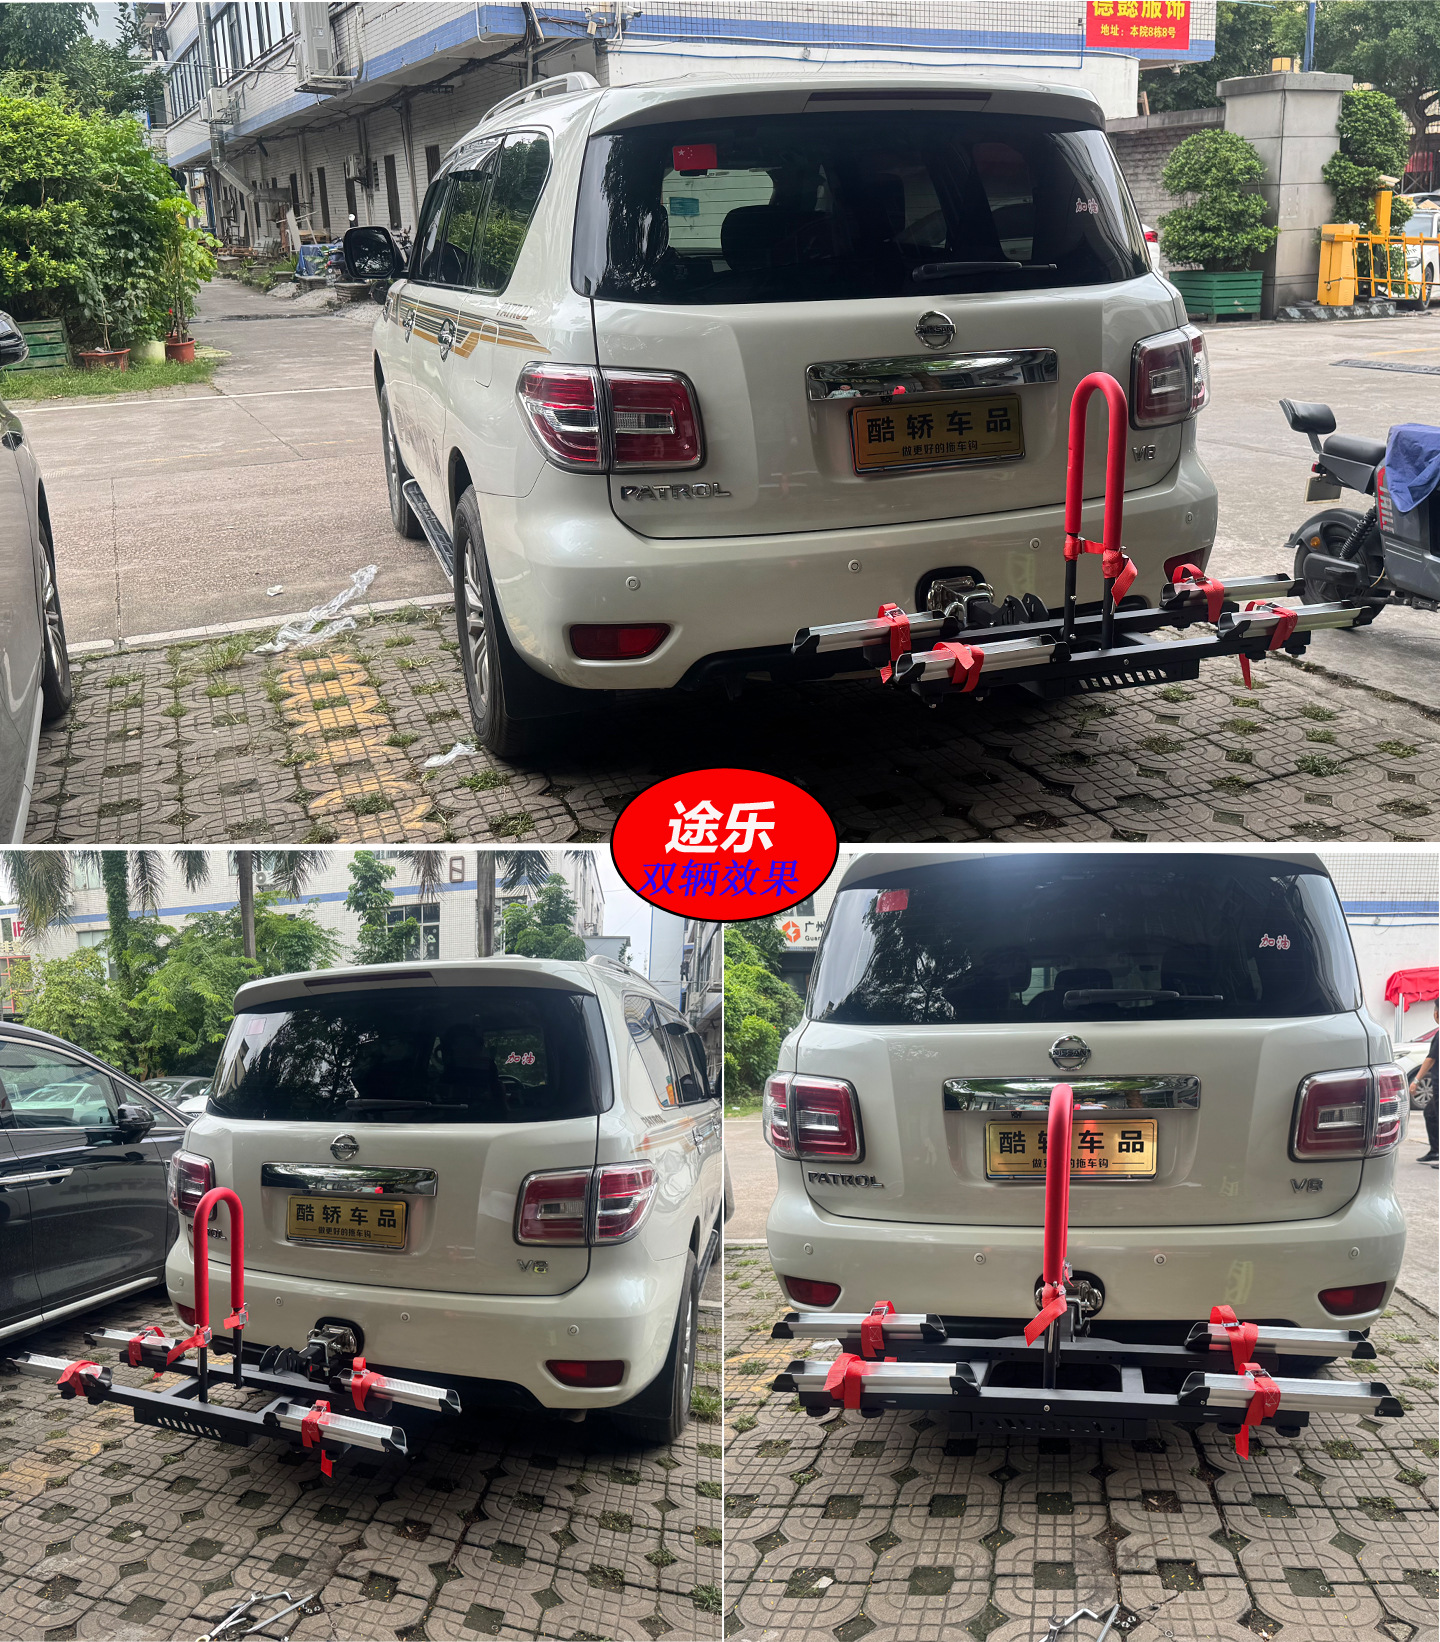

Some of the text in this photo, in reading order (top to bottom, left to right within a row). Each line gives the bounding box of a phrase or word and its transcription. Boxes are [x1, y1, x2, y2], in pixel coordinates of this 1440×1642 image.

[866, 407, 1012, 444] 酷轿车品
[902, 440, 978, 457] 做更好的拖车钩
[620, 482, 732, 501] PATROL
[1259, 933, 1290, 950] 加油
[505, 1051, 535, 1065] 加油
[807, 1170, 885, 1188] PATROL
[296, 1203, 397, 1228] 酷轿车品
[318, 1226, 372, 1239] 做更好的拖车钩
